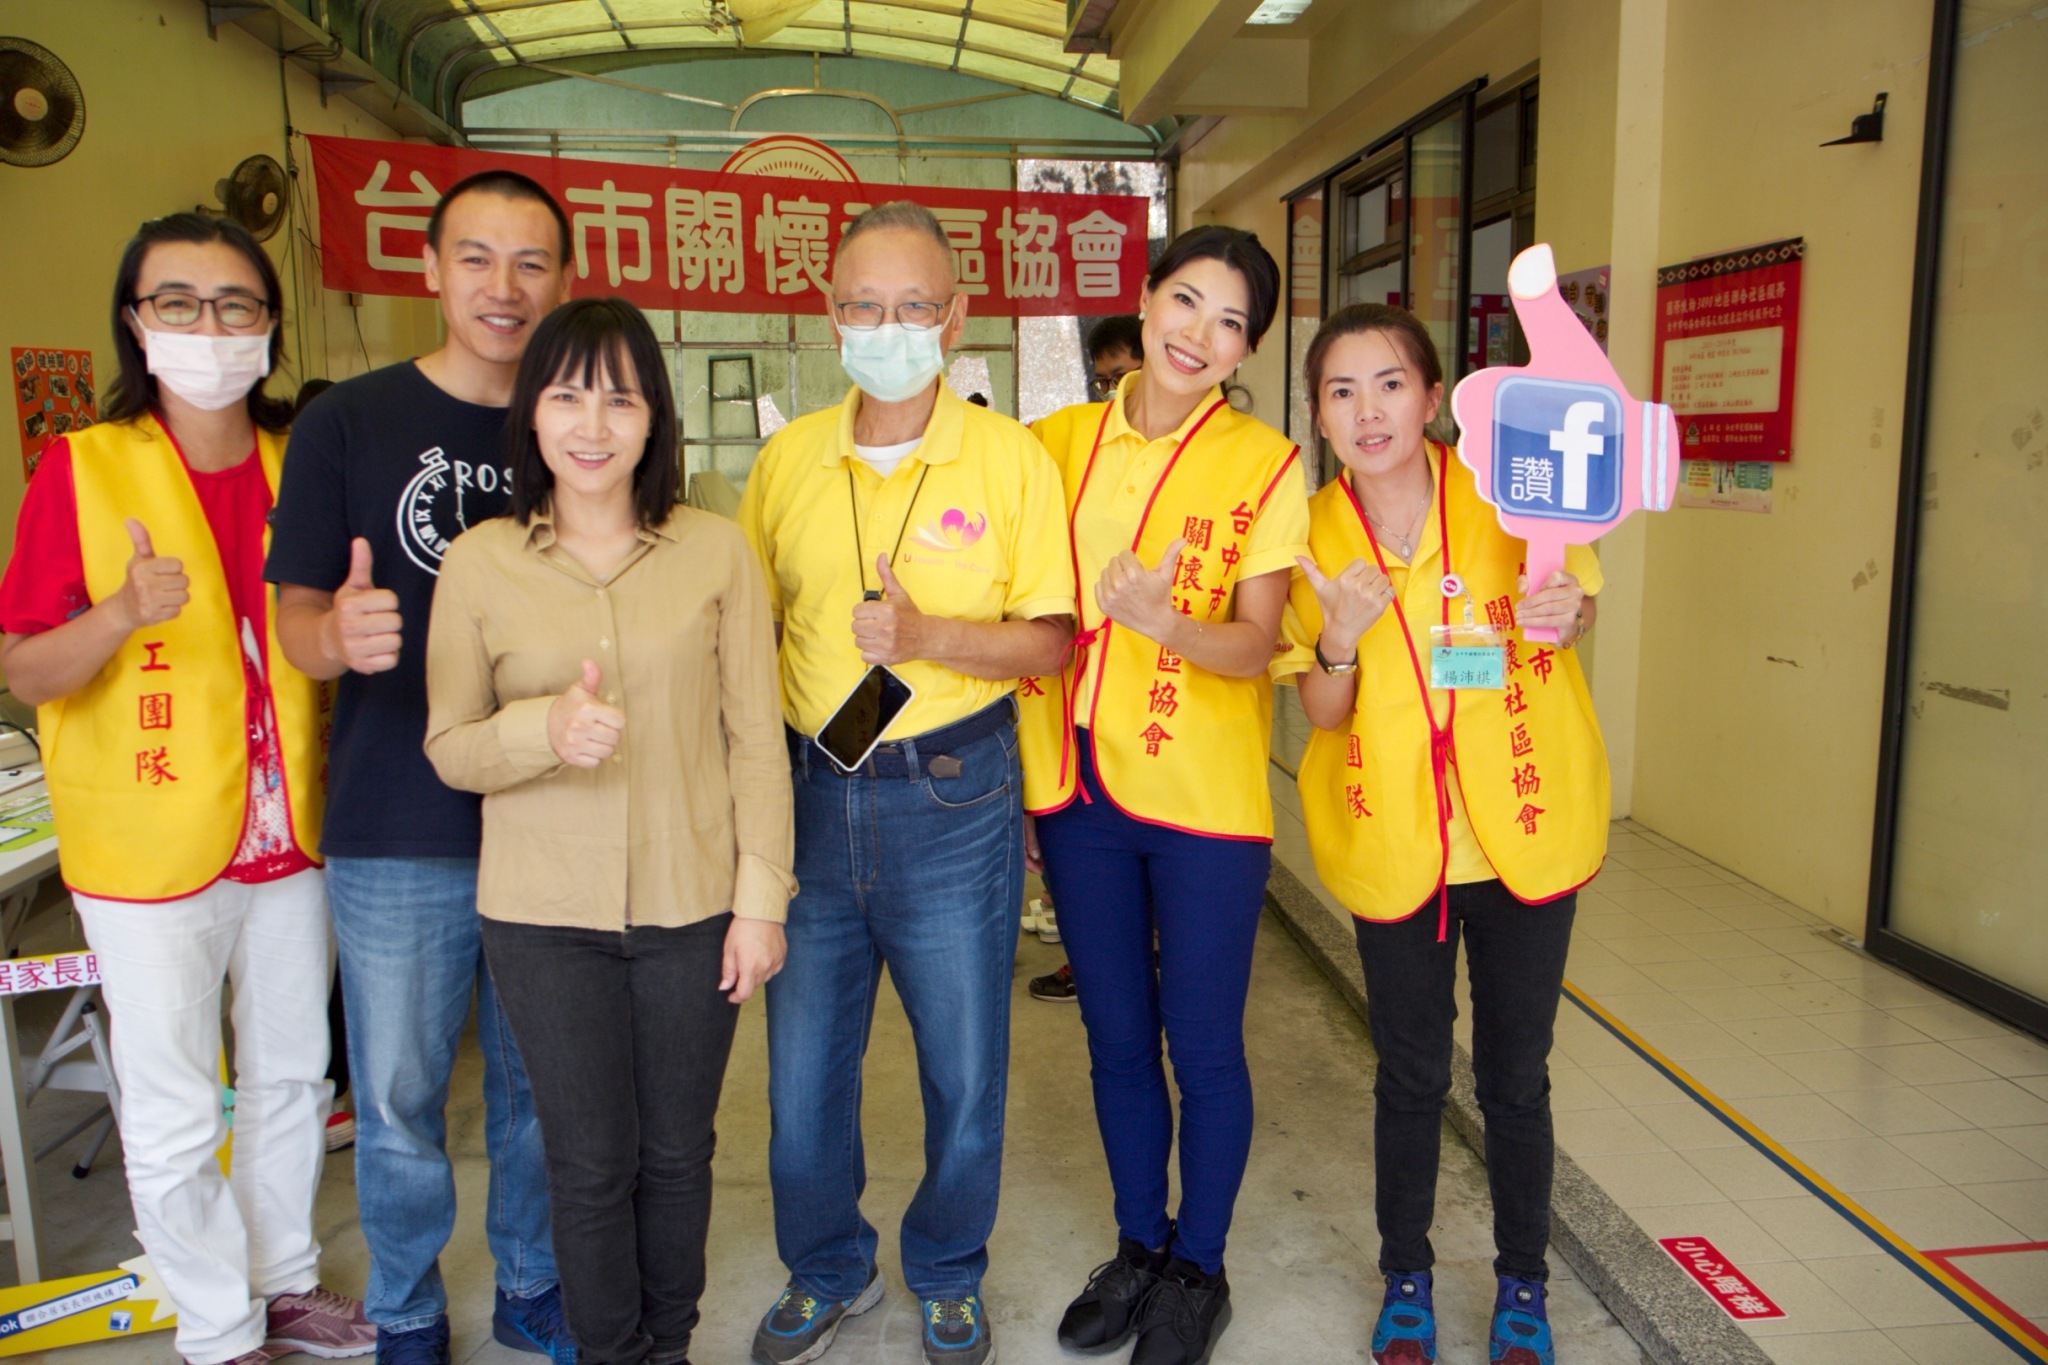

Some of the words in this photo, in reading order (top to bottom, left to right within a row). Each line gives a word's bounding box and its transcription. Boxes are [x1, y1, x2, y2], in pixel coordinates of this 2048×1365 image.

[354, 159, 1128, 300] 台市關懷區協會
[1511, 456, 1553, 504] 讚
[1549, 401, 1604, 510] f
[1210, 501, 1254, 619] 台中市
[136, 641, 179, 786] 工團隊
[1484, 595, 1546, 836] 關懷社區協會
[1345, 733, 1374, 820] 團隊
